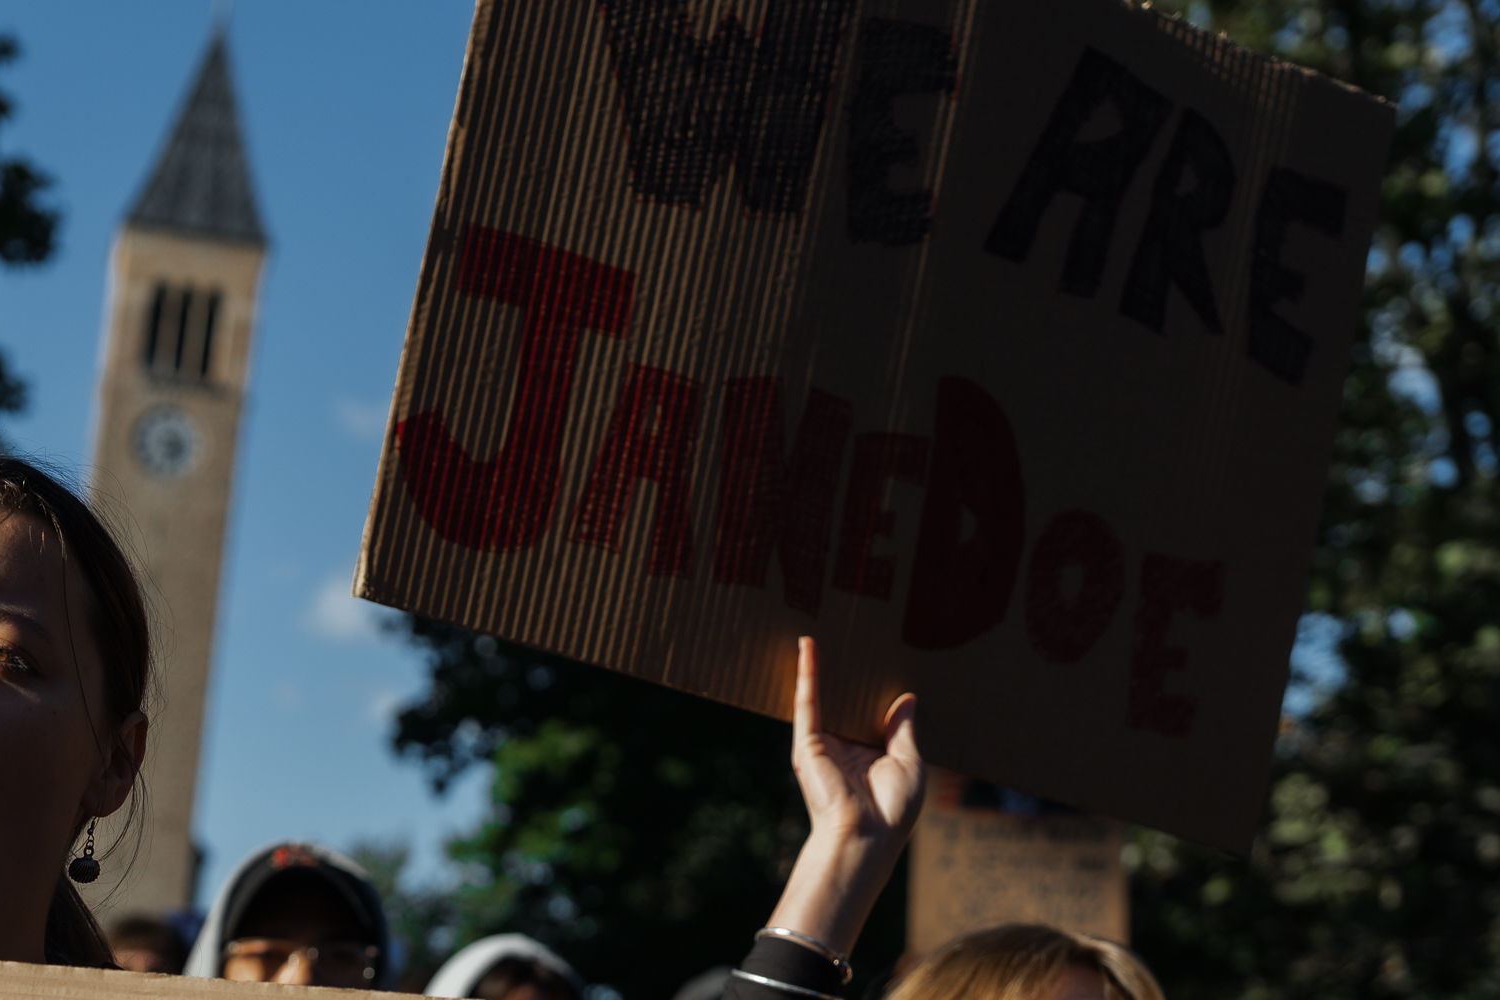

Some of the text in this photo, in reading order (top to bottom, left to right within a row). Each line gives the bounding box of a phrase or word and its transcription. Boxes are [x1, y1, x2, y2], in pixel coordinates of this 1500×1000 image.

[598, 0, 1348, 385] WE ARE
[396, 222, 1226, 738] JANE DOE
